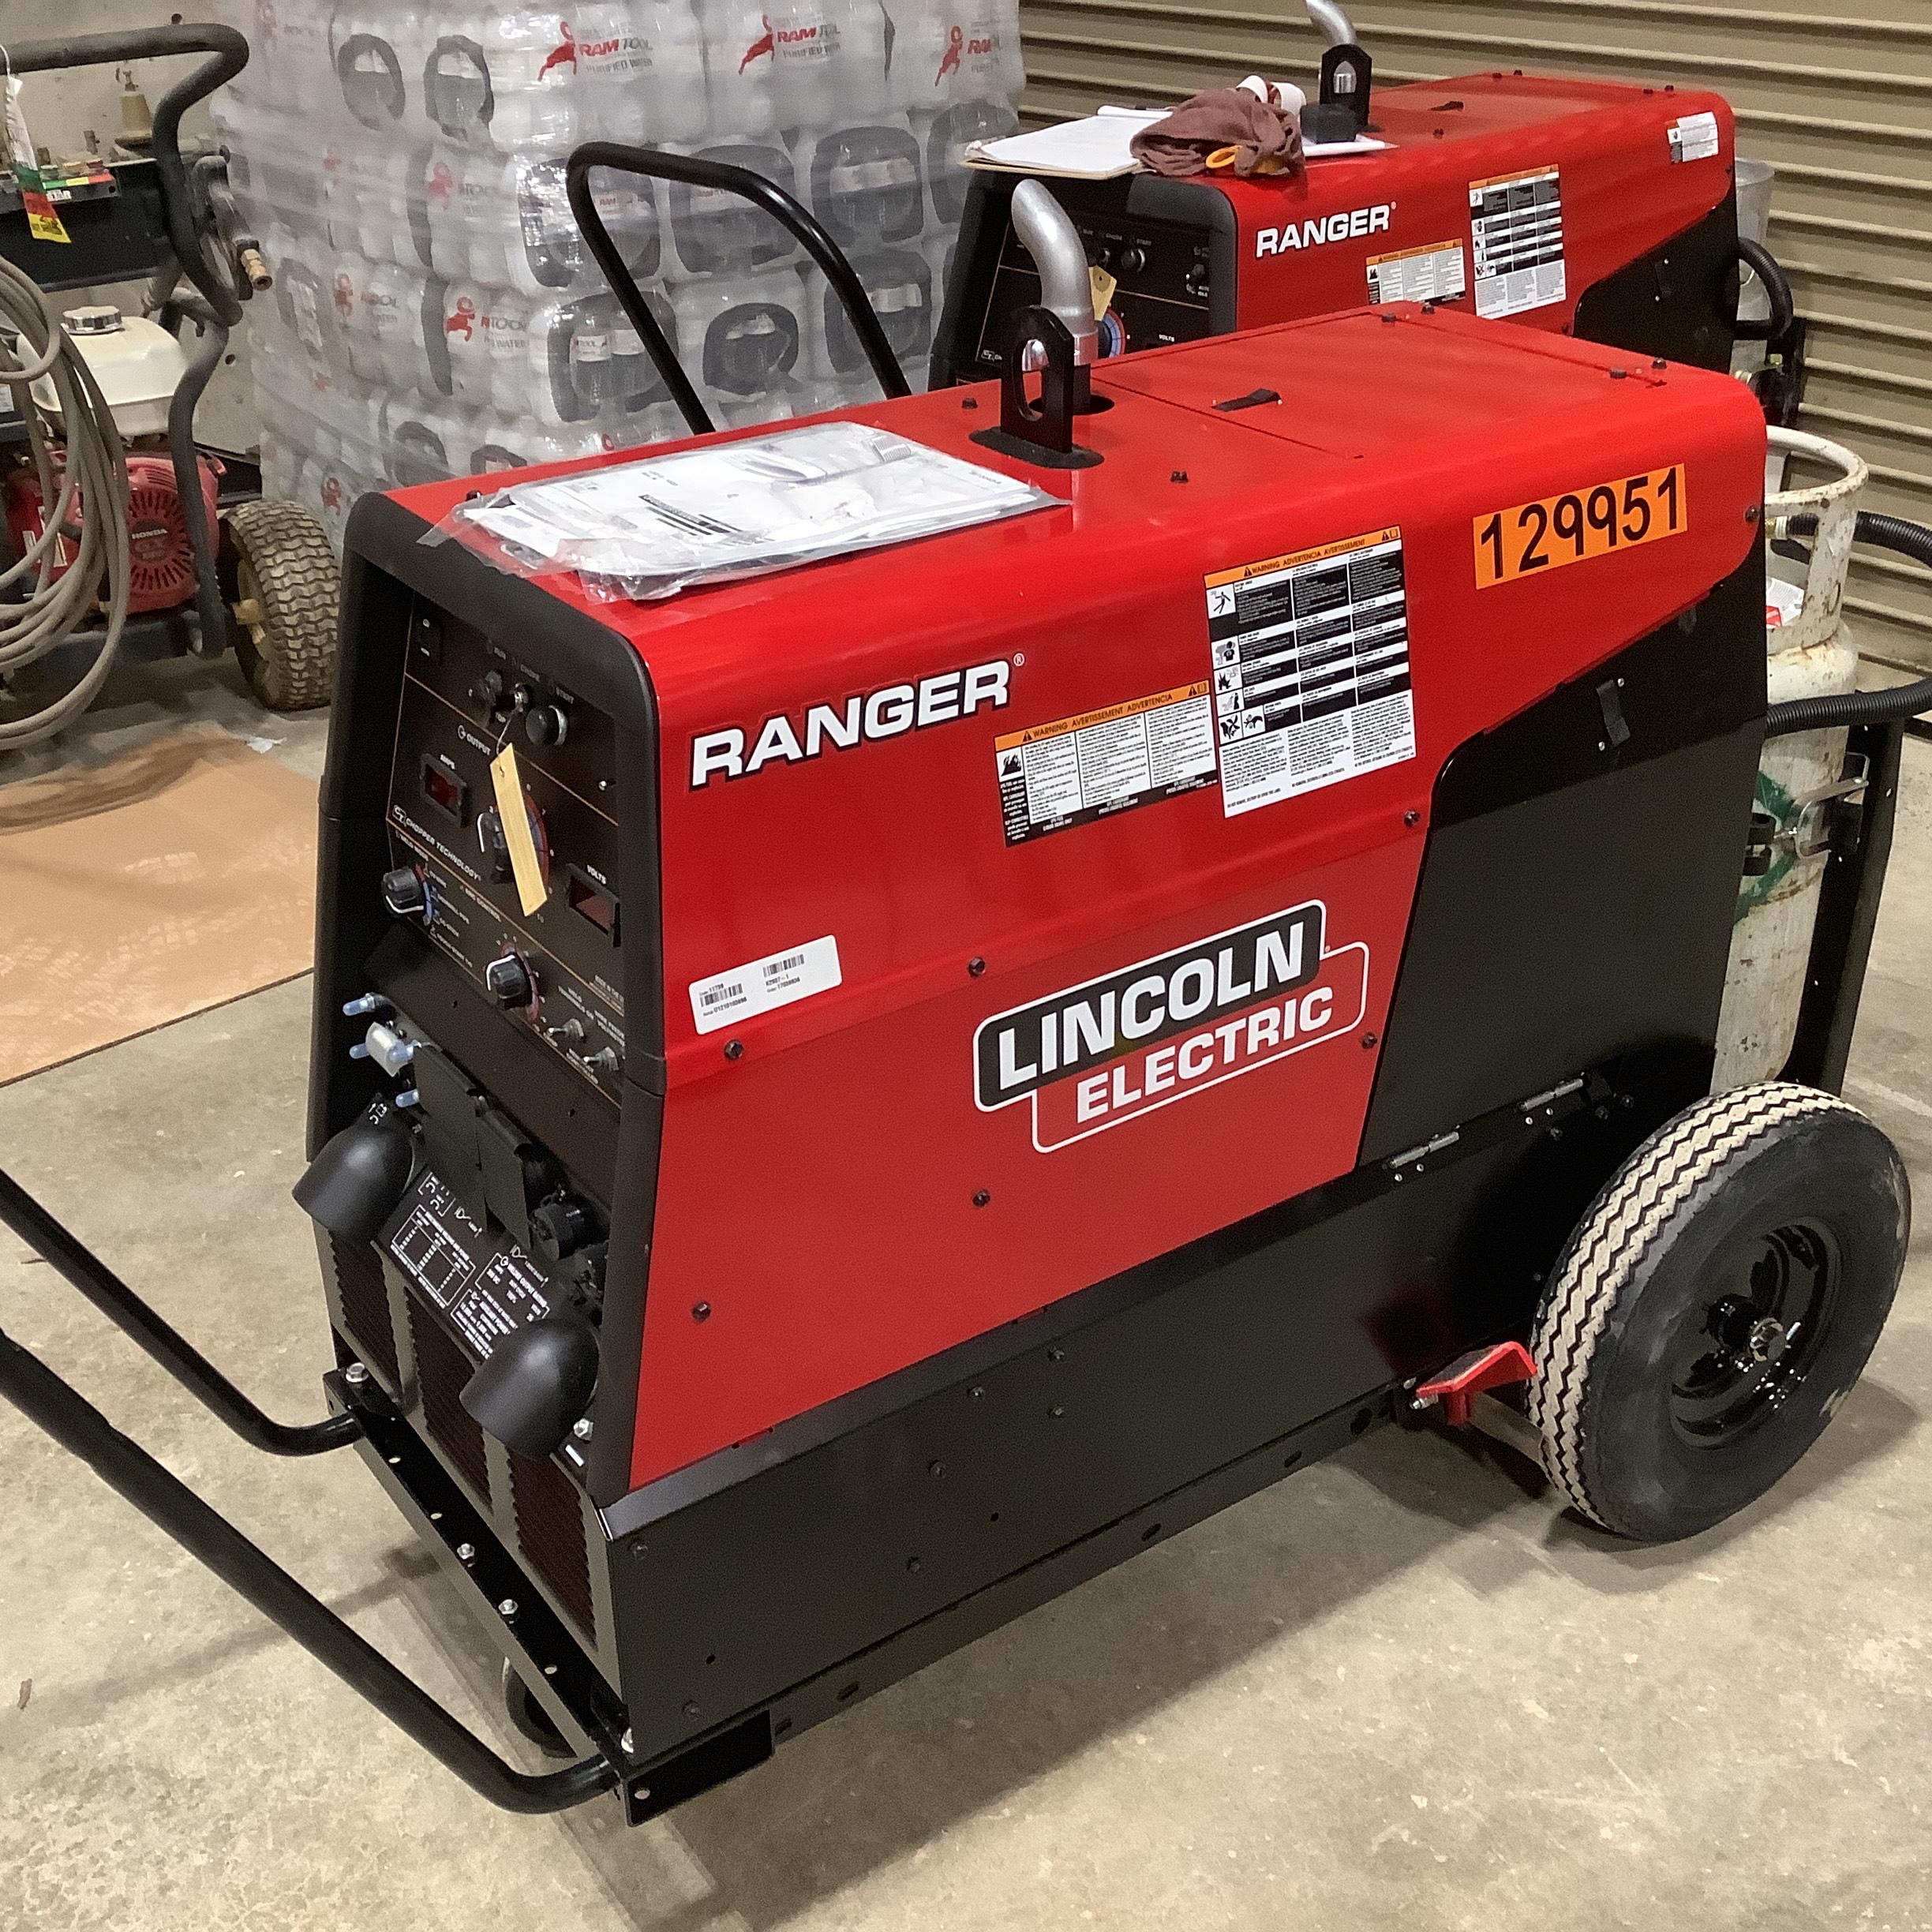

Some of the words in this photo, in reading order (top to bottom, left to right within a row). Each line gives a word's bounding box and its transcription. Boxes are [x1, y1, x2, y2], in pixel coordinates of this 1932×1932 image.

[579, 39, 619, 56] RAM
[777, 27, 817, 43] RAM
[132, 529, 168, 540] HONDA
[1480, 466, 1678, 580] 129951
[1252, 560, 1280, 575] WARNING
[1032, 722, 1068, 739] WARNING
[1072, 706, 1124, 728] AVERTISSEMENT
[1127, 694, 1173, 713] ADVERTENCIA
[406, 818, 435, 845] CHOPPER
[998, 921, 1305, 1091] LINCOLN
[1076, 987, 1334, 1125] ELECTRIC
